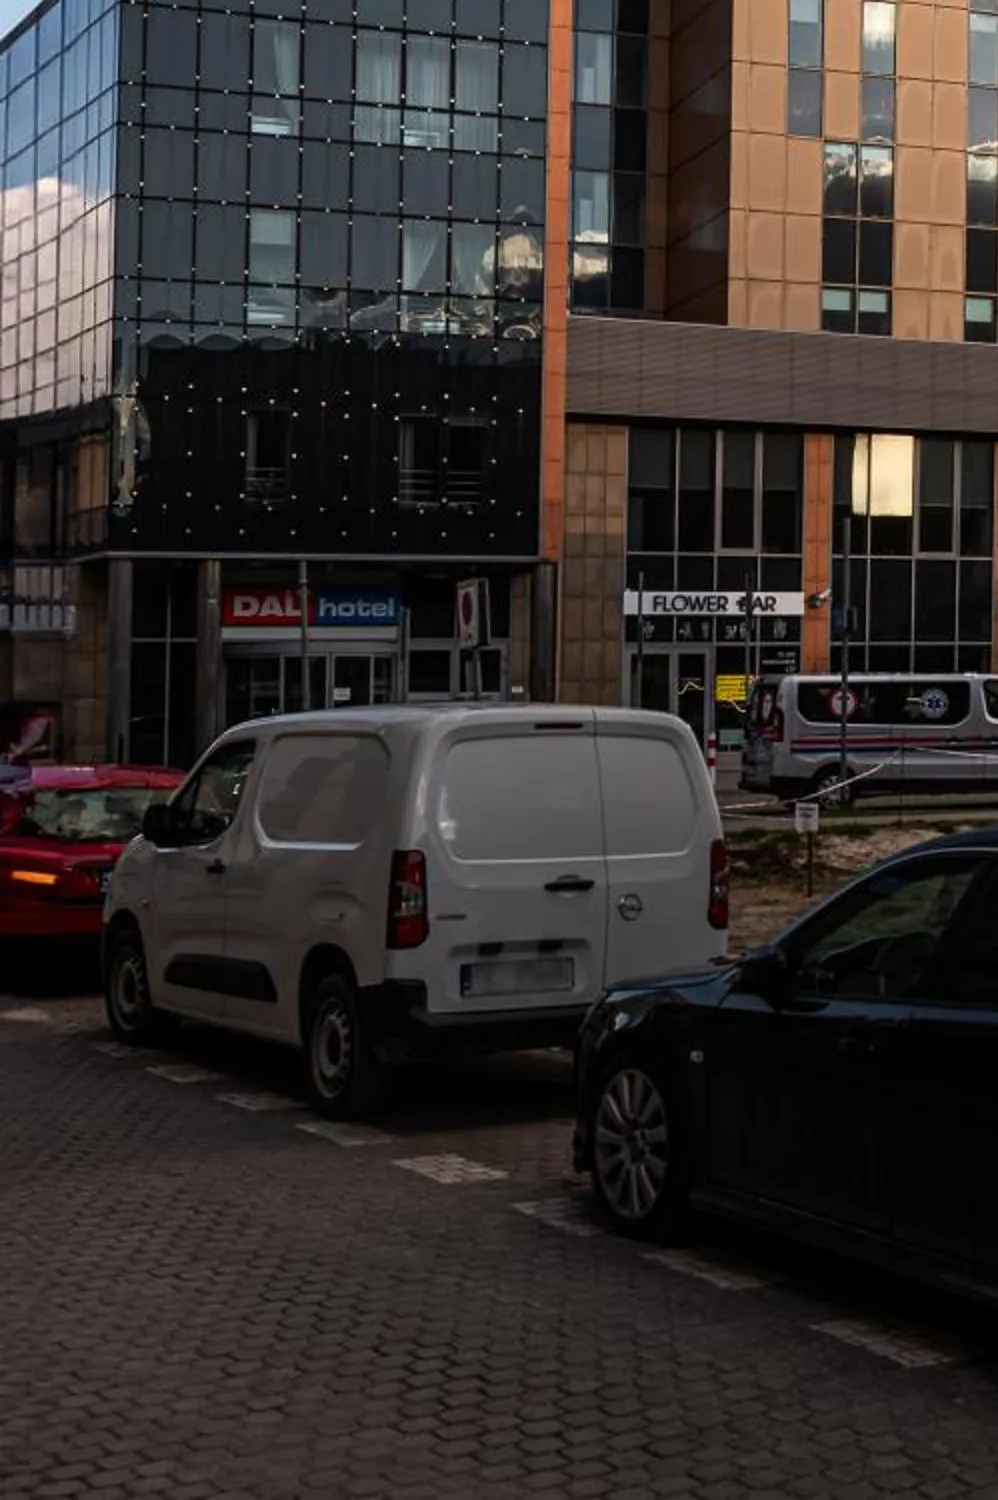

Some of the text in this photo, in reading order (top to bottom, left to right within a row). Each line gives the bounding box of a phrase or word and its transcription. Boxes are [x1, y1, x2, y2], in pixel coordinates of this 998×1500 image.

[232, 594, 395, 617] DAL hotel
[653, 595, 729, 612] FLOWER
